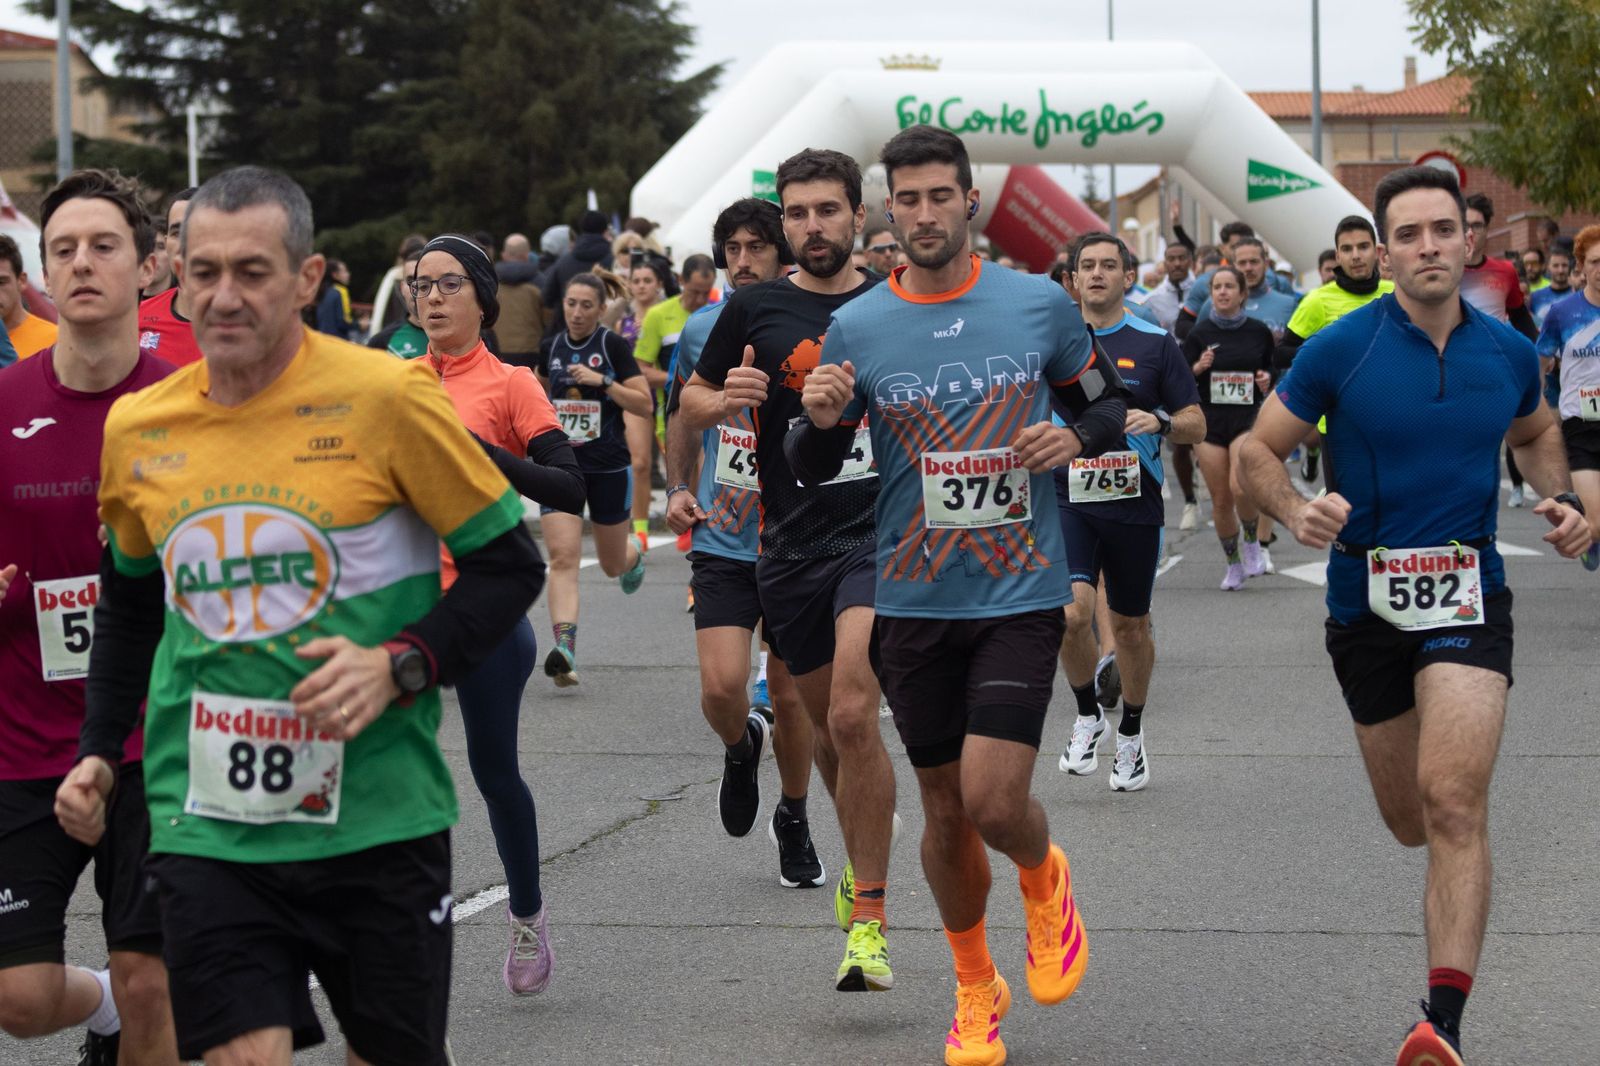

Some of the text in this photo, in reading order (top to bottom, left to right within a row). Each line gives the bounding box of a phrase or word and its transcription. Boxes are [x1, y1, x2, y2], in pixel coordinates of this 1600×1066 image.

[896, 88, 1164, 149] El Corte Inglés
[933, 328, 956, 339] MKA
[875, 351, 1041, 421] SAN
[875, 370, 1042, 407] SILVESTRE
[1219, 382, 1246, 397] 175
[559, 413, 590, 431] 775
[942, 473, 1013, 511] 376
[1080, 468, 1128, 491] 765
[203, 484, 334, 526] DEPORTIVO
[175, 551, 320, 595] ALCER
[1389, 573, 1462, 611] 582
[62, 611, 91, 654] 5
[228, 742, 294, 793] 88
